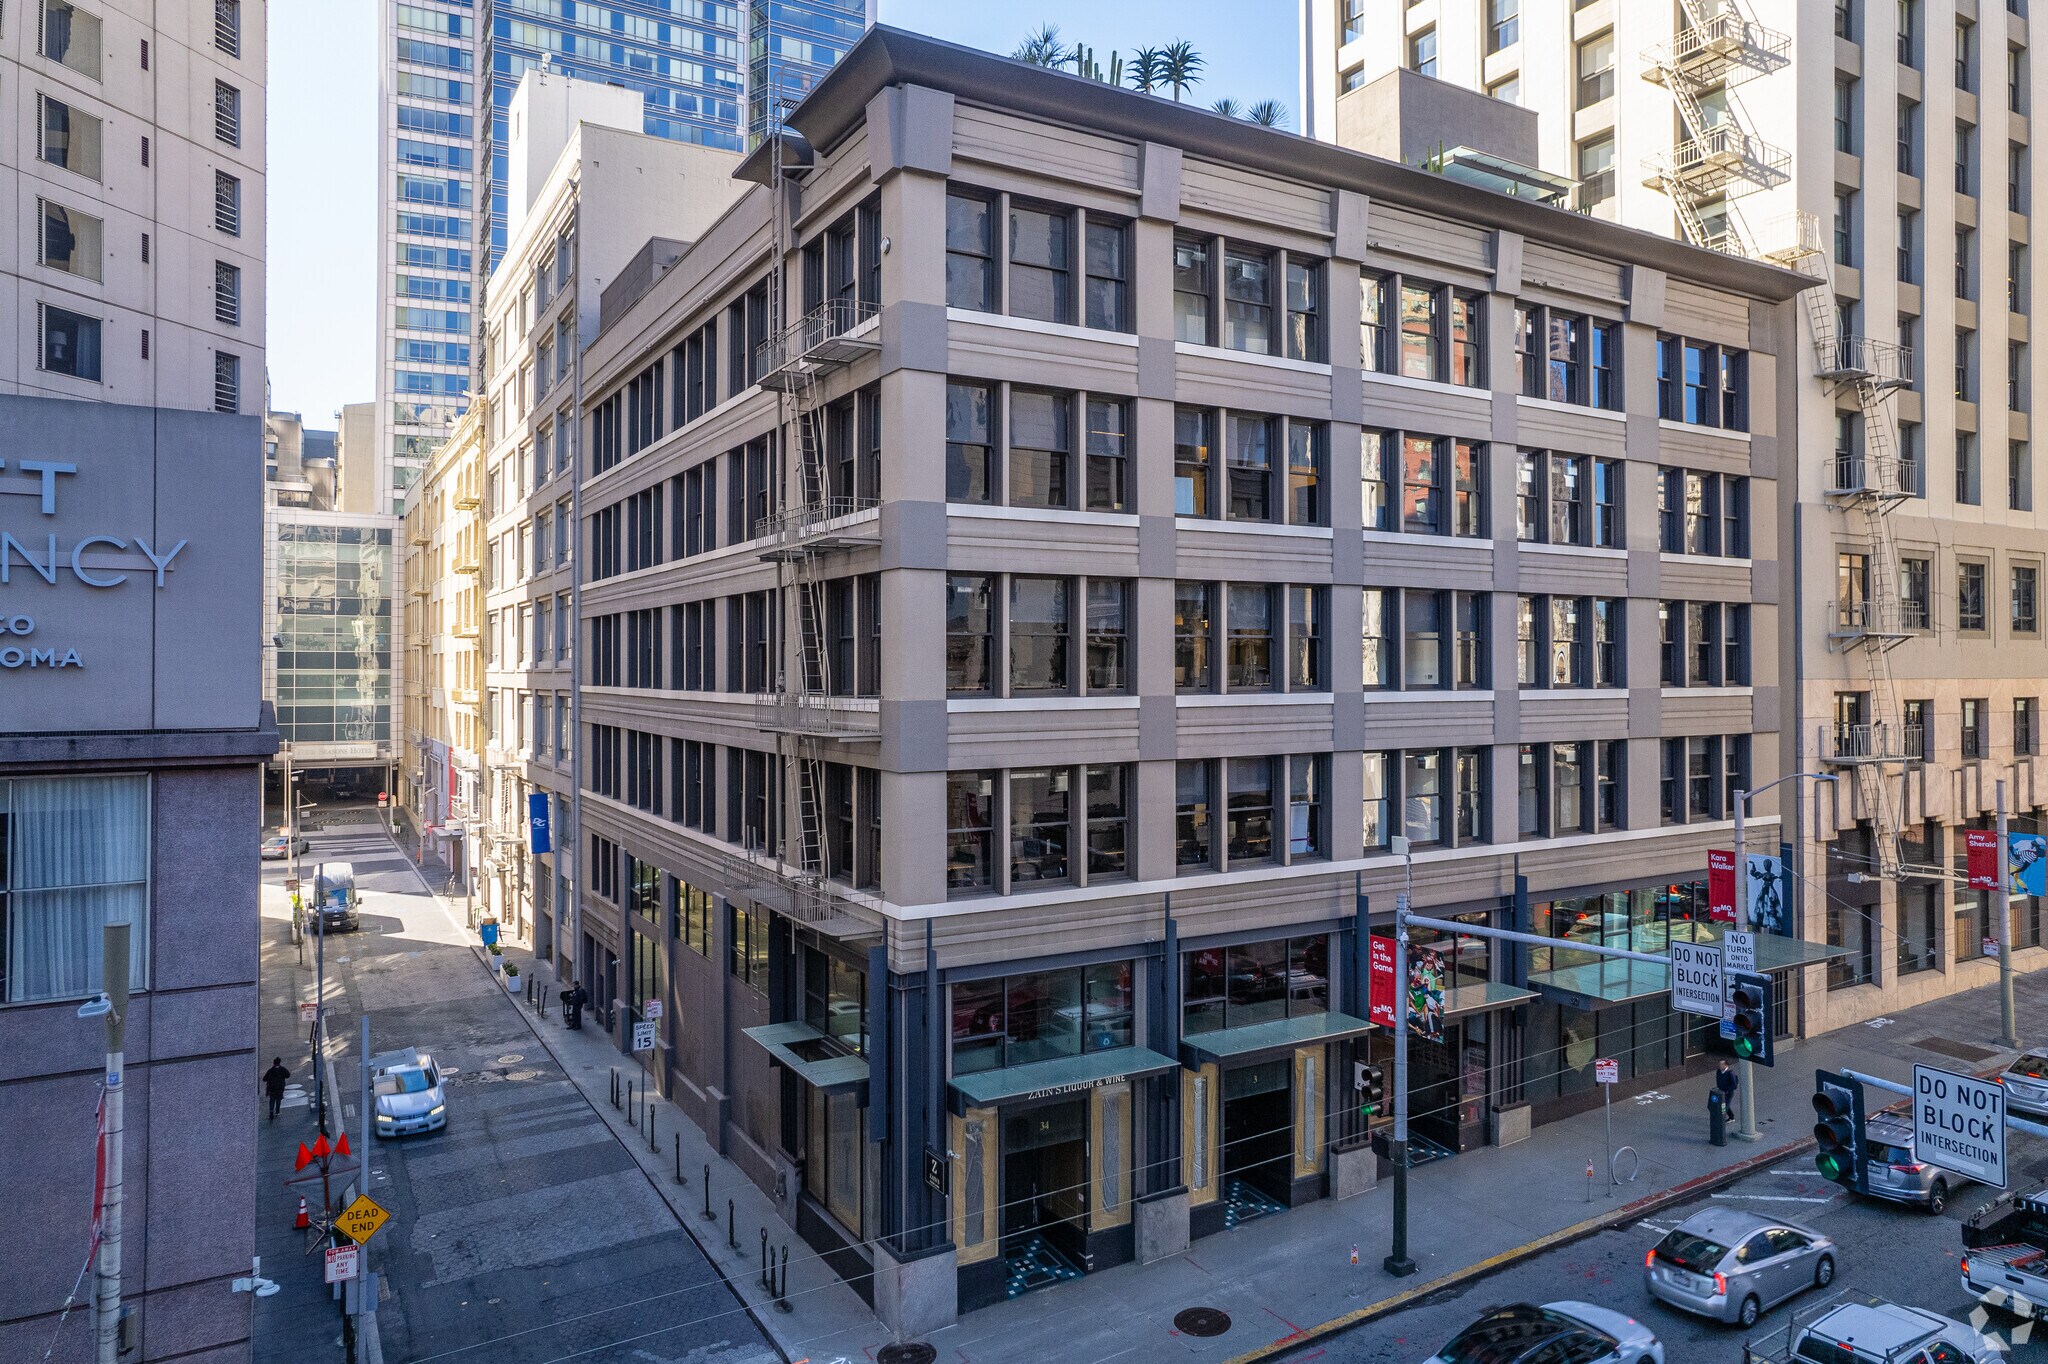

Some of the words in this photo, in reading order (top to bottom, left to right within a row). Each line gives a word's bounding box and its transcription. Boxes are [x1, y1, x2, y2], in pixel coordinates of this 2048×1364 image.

[1968, 833, 1985, 841] Amy
[1969, 840, 1996, 848] Sherald
[1710, 853, 1727, 861] Kara
[1711, 862, 1735, 871] Walker
[1731, 934, 1746, 945] NO
[1372, 940, 1385, 951] Get
[1726, 945, 1753, 955] TURNS
[1372, 951, 1379, 960] in
[1380, 953, 1391, 963] the
[1674, 947, 1691, 963] DO
[1696, 951, 1719, 968] NOT
[1730, 954, 1748, 962] ONTO
[1373, 961, 1394, 974] Game
[1727, 962, 1753, 971] MARKET
[1678, 968, 1718, 988] BLOCK
[1676, 987, 1720, 1003] INTERSECTION
[637, 1037, 652, 1048] 15
[1028, 1087, 1062, 1100] ZAIN'S
[1105, 1074, 1126, 1085] WINE
[1920, 1074, 1947, 1099] DO
[1957, 1084, 2000, 1114] NOT
[1039, 1121, 1049, 1131] 34
[1924, 1104, 1995, 1144] BLOCK
[1921, 1131, 1998, 1165] INTERSECTION
[931, 1159, 938, 1175] Z
[347, 1208, 379, 1221] DEAD
[351, 1221, 375, 1233] END
[327, 1254, 336, 1263] NO
[336, 1253, 356, 1261] PARKING
[335, 1267, 349, 1275] TIME
